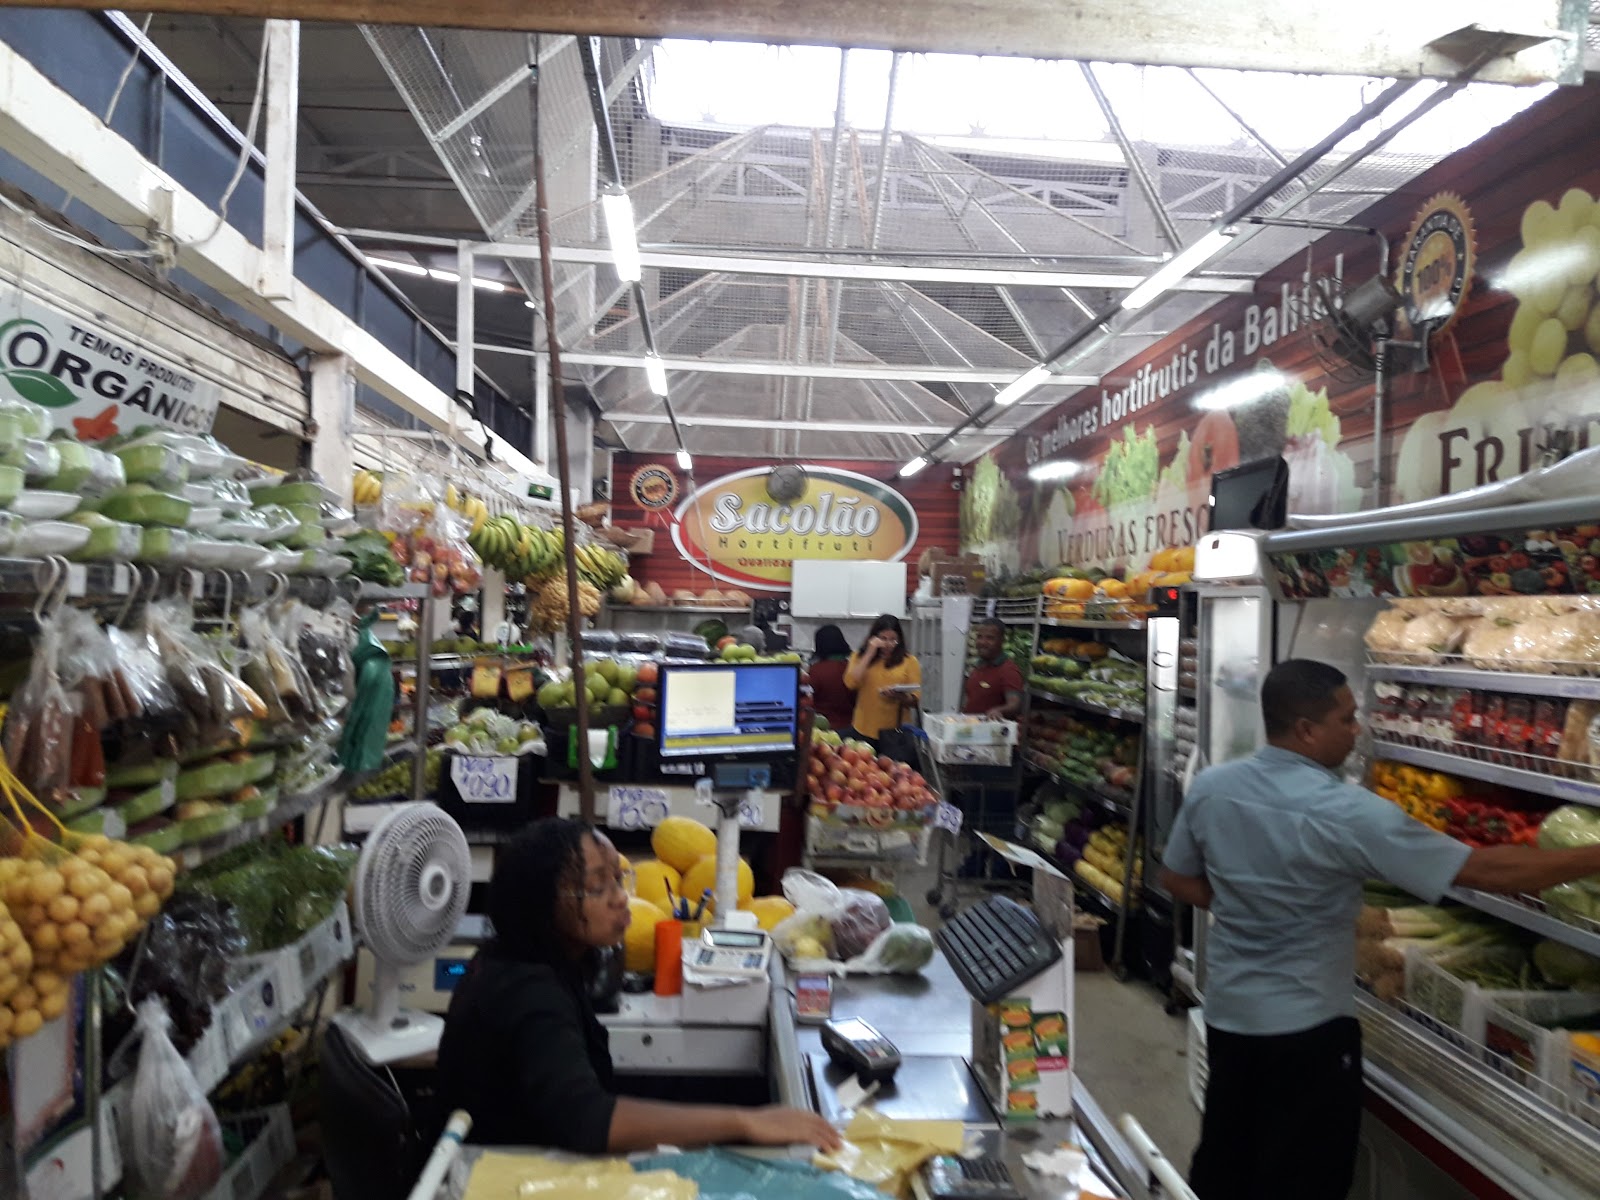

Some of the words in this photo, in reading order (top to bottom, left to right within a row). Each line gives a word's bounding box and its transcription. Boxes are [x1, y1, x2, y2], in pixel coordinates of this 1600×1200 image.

[8, 330, 214, 434] ORGÂNICOS
[69, 325, 133, 366] TEMOS
[135, 357, 196, 394] PRODUTOS
[1041, 404, 1099, 452] melhores
[1101, 344, 1199, 426] hortifrutis
[1205, 323, 1235, 373] da
[709, 492, 880, 536] Sacolão
[1057, 519, 1138, 565] VERDURAS
[718, 536, 874, 552] Hortifruti
